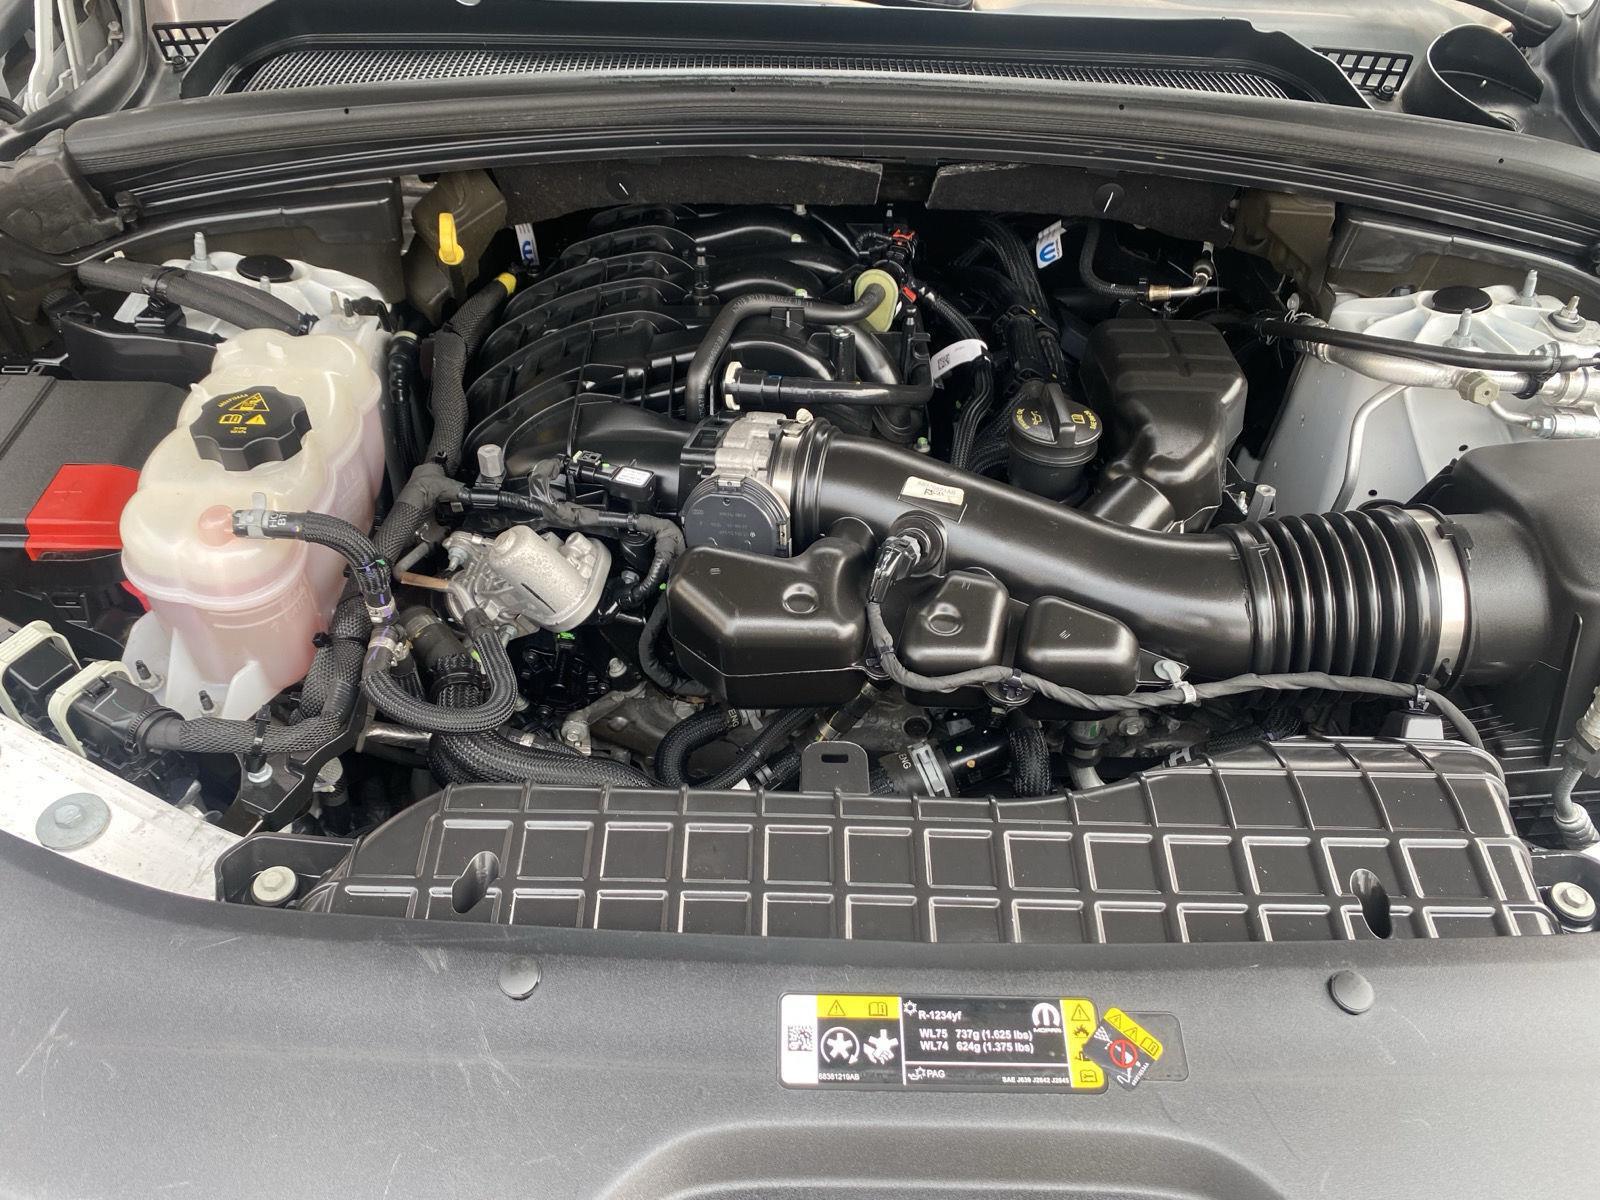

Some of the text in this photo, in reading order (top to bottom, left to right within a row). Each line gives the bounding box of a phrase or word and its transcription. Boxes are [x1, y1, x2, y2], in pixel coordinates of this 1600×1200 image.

[727, 708, 740, 728] ENG
[897, 752, 912, 770] ENG
[918, 1010, 962, 1022] R-1234yf
[919, 1029, 1033, 1042] WL75 737g (1.625 lbs)
[920, 1041, 1034, 1054] WL74 624g (1.375 lbs)
[927, 1070, 945, 1078] PAG
